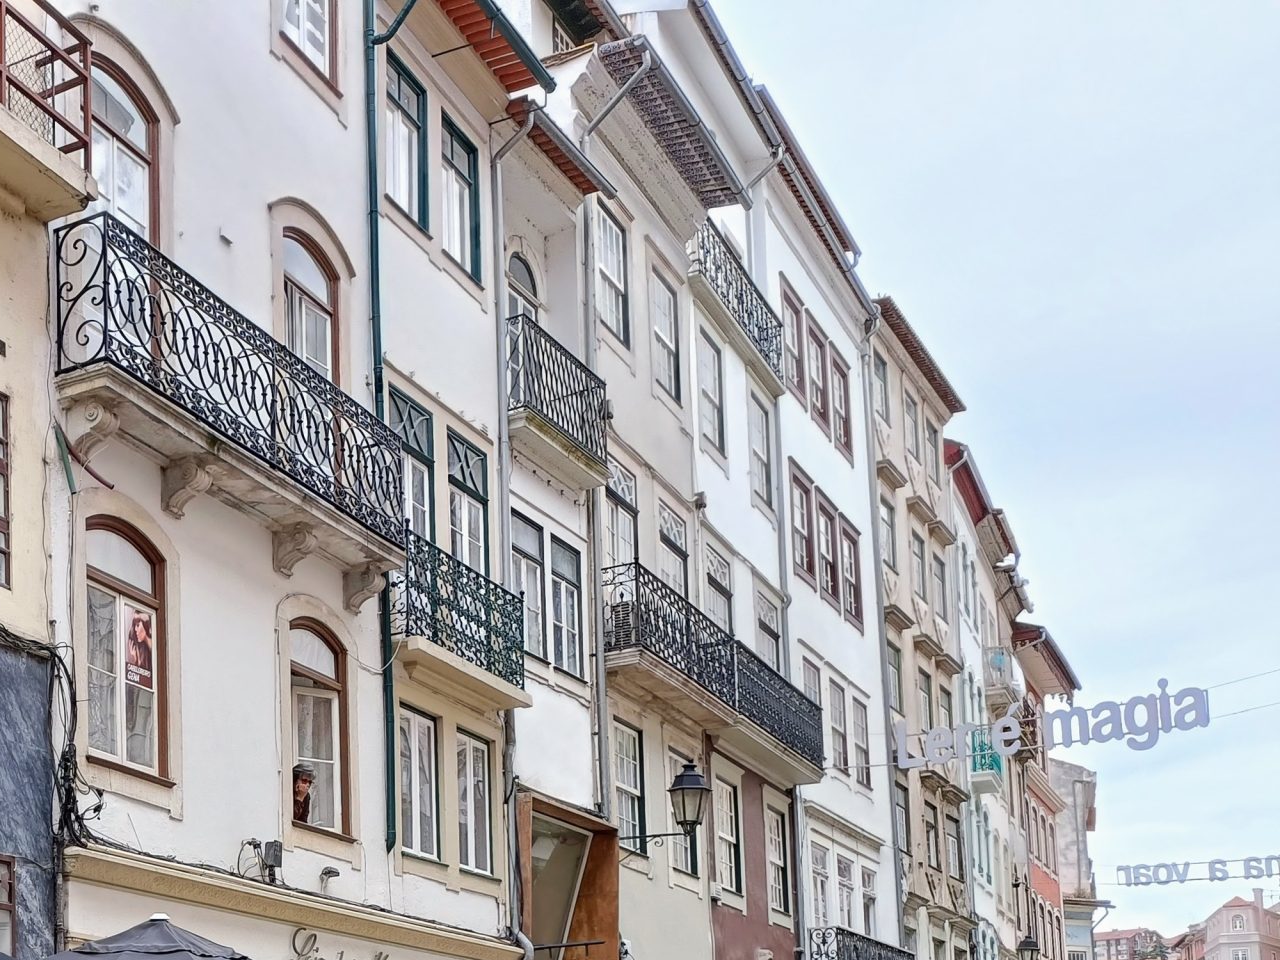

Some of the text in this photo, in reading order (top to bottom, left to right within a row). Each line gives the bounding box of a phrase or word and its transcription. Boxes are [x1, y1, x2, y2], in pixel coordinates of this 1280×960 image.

[896, 678, 1208, 768] Ler é magia
